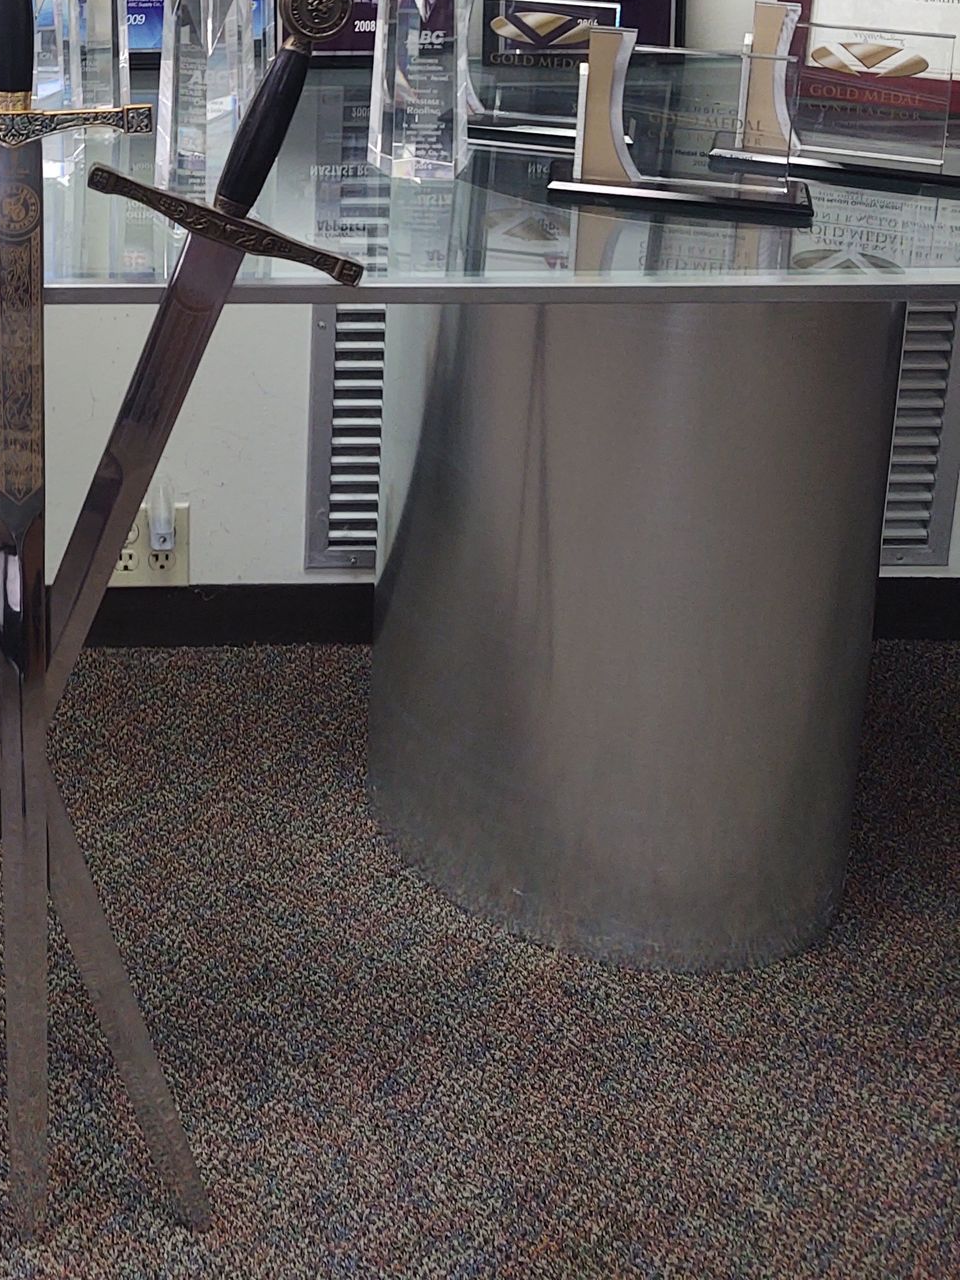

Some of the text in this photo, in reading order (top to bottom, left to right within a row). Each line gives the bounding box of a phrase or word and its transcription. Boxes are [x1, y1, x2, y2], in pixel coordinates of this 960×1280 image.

[354, 20, 376, 32] 2008
[490, 53, 582, 69] GOLD MEDA
[809, 84, 923, 106] GOLD MEDAL
